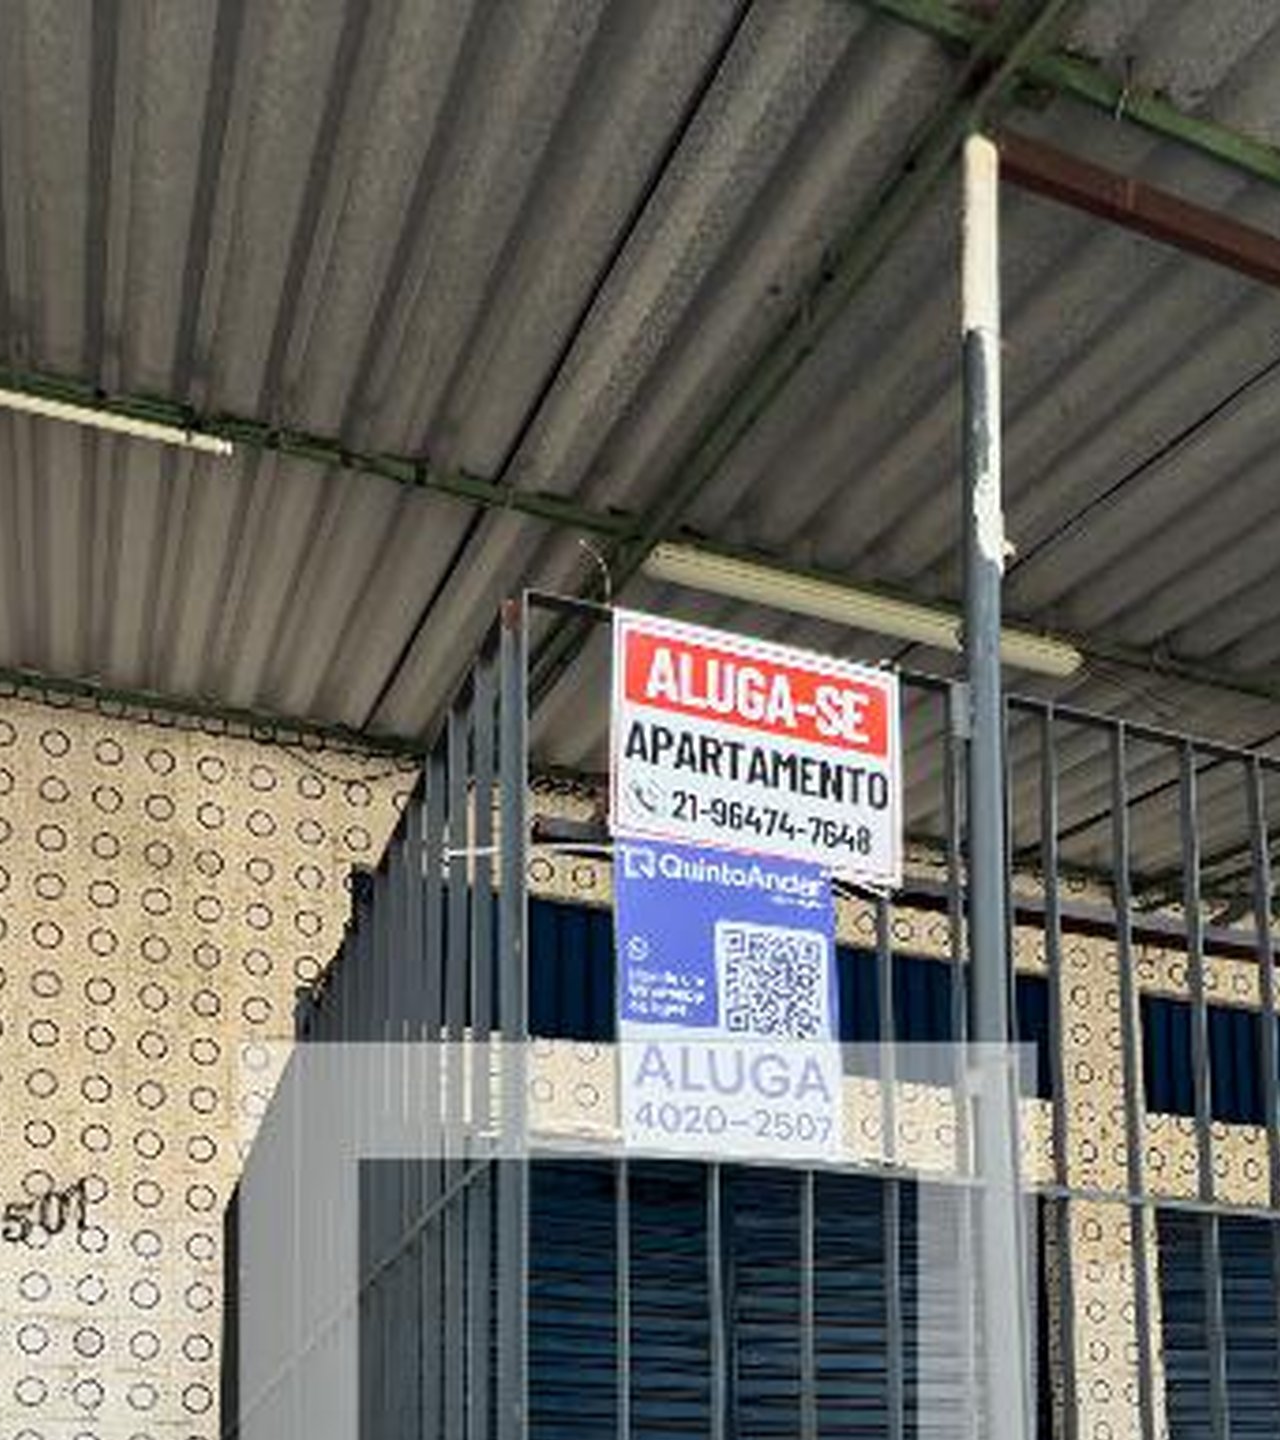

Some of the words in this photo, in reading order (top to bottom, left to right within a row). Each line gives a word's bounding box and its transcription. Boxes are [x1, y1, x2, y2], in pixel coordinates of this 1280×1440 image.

[644, 647, 870, 744] ALUGA-SE
[624, 720, 889, 811] APARTAMENTO
[671, 790, 872, 856] 21-96474-7648
[634, 1044, 831, 1102] ALUGA
[635, 1102, 833, 1143] 4020-2507
[2, 1177, 87, 1243] 501
